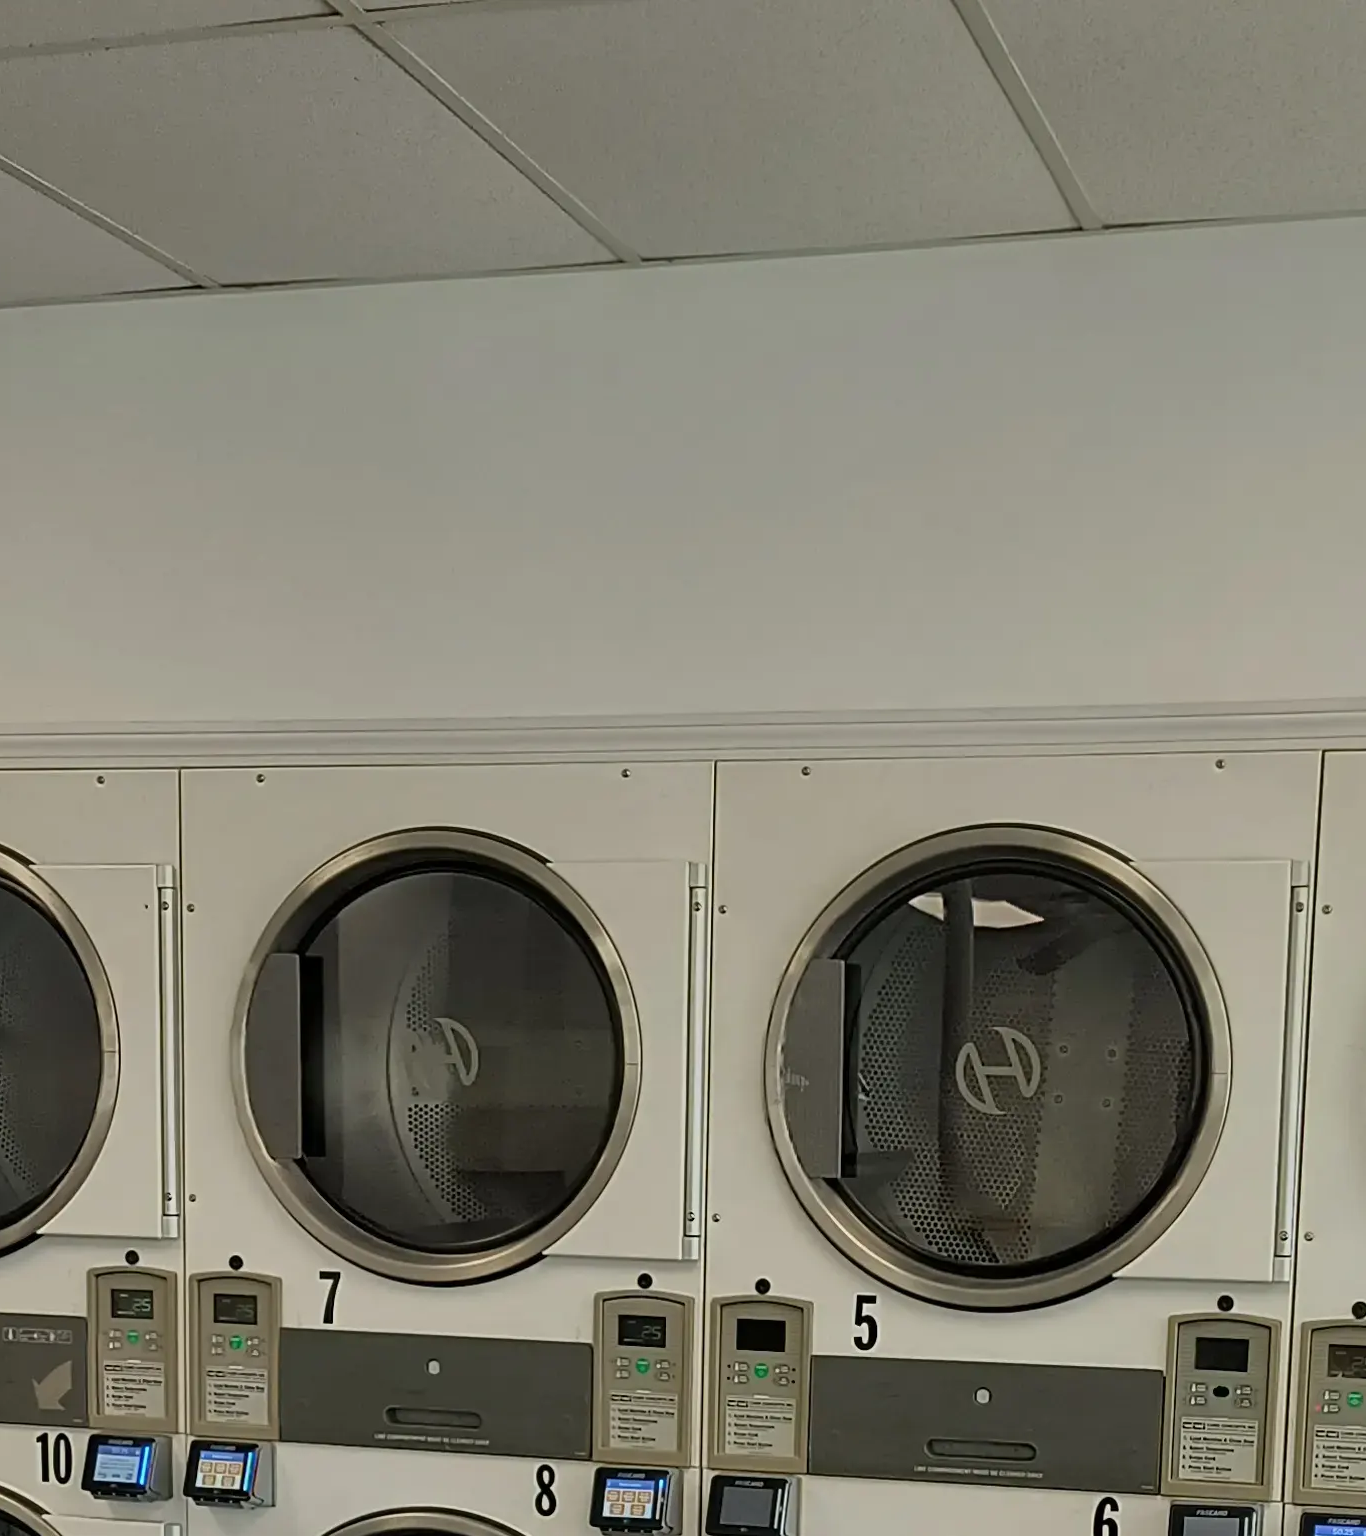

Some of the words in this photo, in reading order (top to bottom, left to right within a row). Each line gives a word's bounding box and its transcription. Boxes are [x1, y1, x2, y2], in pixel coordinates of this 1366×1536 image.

[318, 1271, 341, 1324] 7
[853, 1294, 878, 1351] 5
[36, 1433, 73, 1484] 10
[534, 1464, 557, 1517] 8
